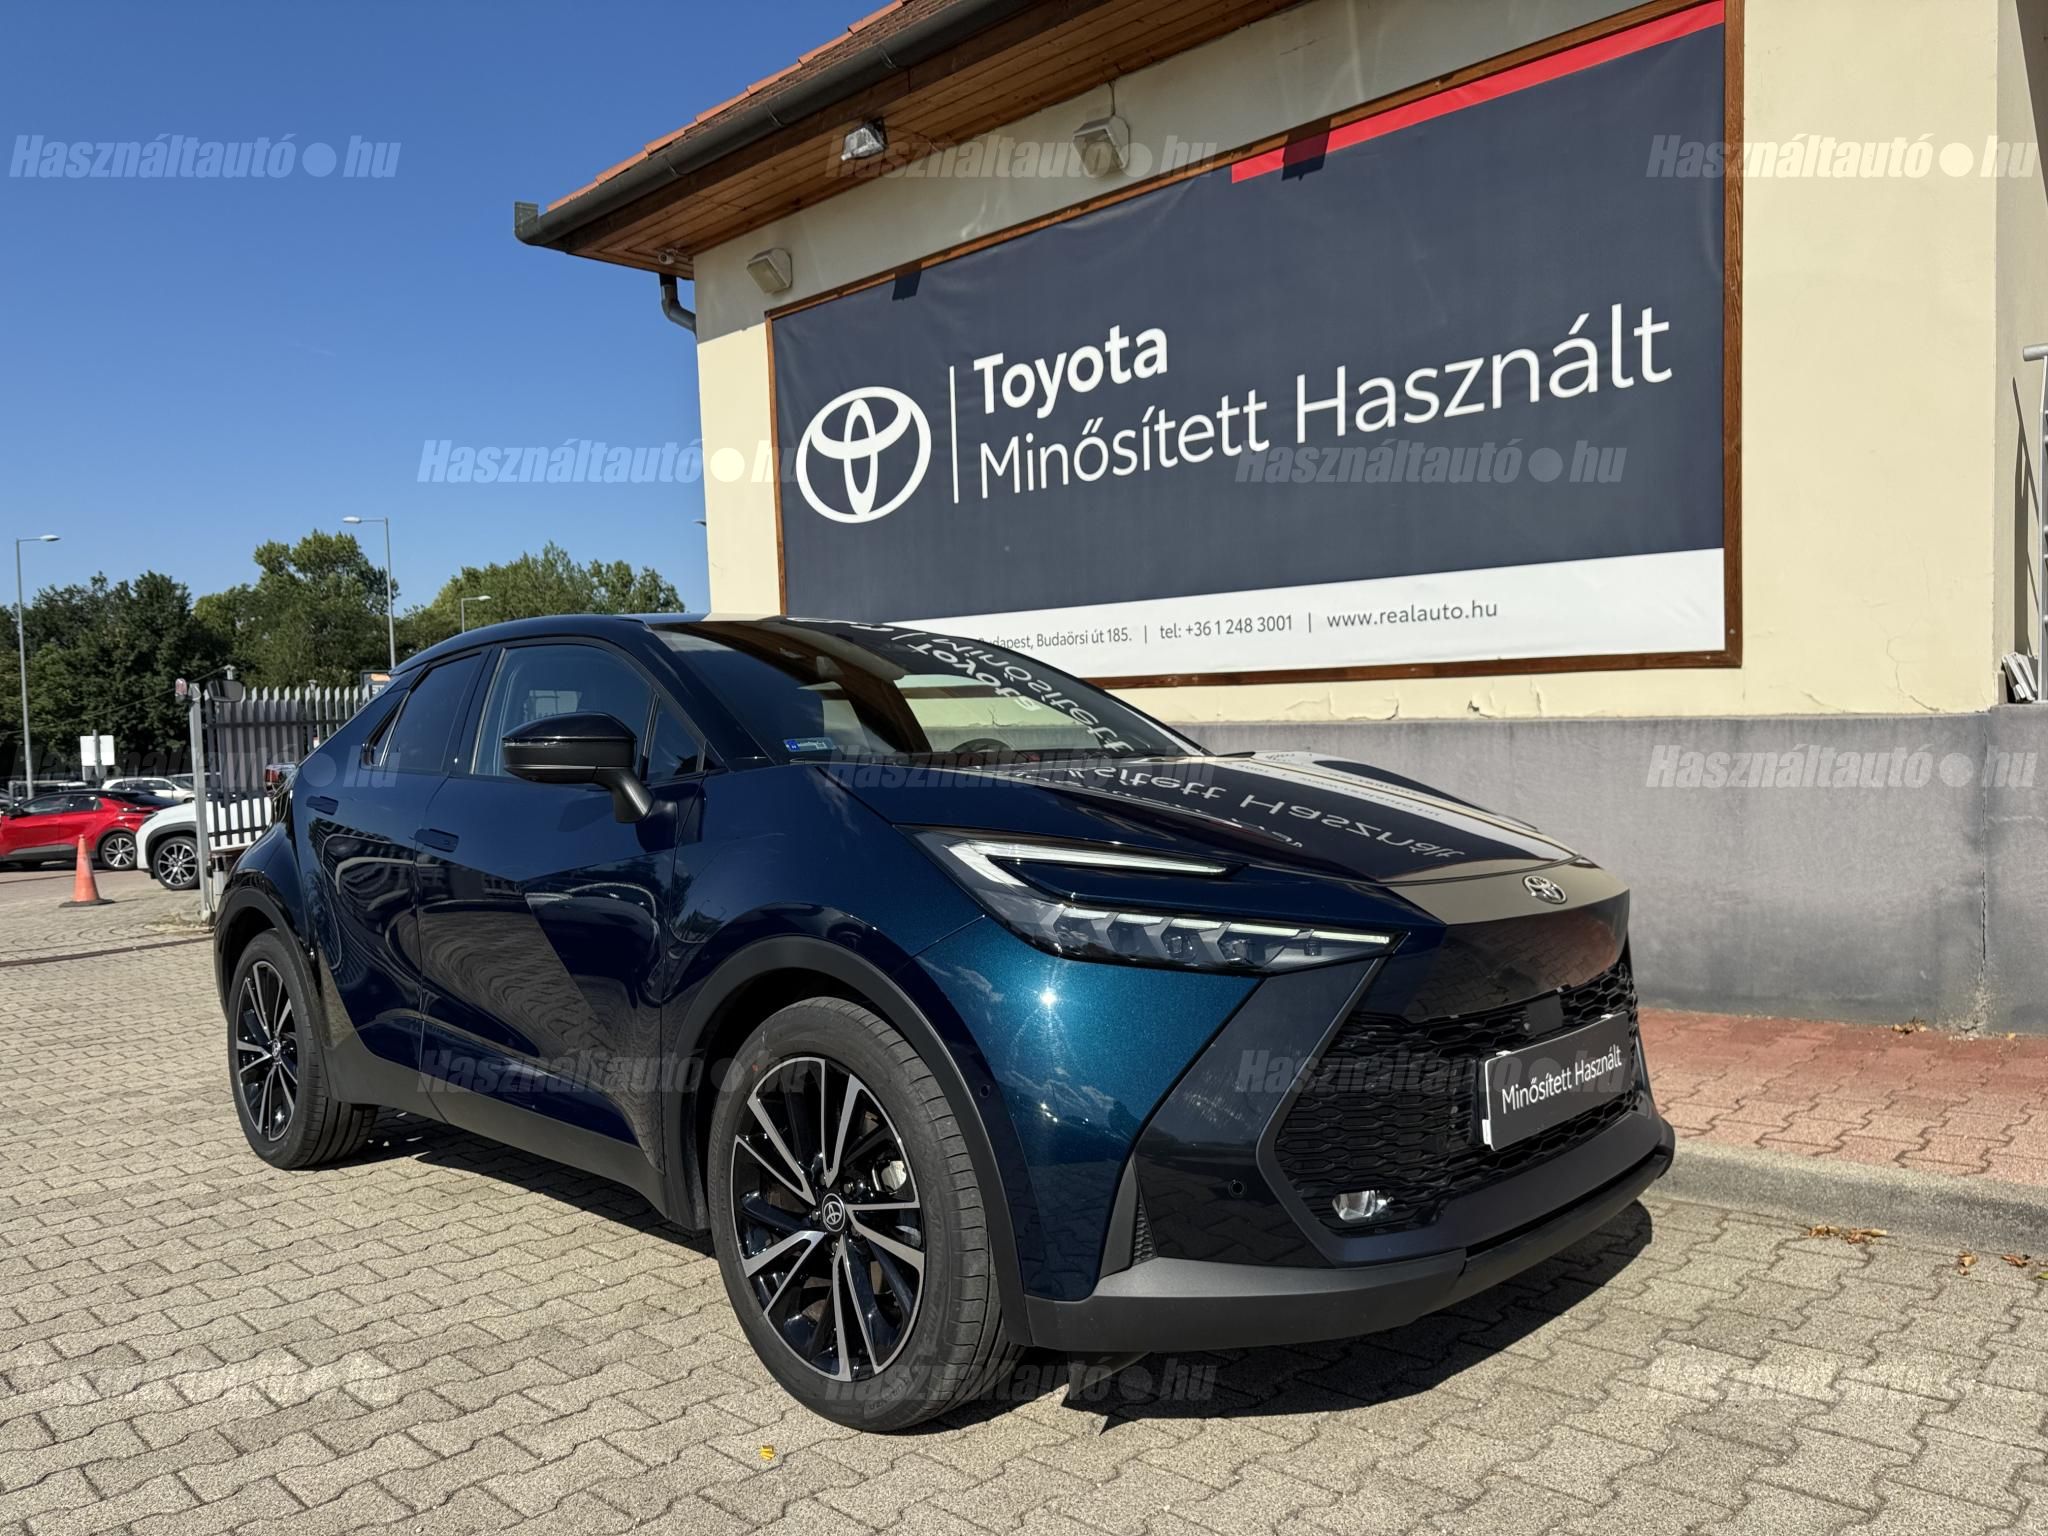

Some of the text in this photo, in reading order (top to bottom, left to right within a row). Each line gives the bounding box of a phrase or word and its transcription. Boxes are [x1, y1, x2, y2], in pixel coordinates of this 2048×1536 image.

[973, 325, 1168, 419] Toyota
[980, 304, 1673, 499] Minősített Használt
[1036, 630, 1088, 647] Budaörsi
[1091, 629, 1105, 644] út
[1107, 627, 1132, 642] 185.
[1160, 623, 1182, 639] tel:
[1225, 617, 1253, 634] 248
[1257, 614, 1292, 632] 3001
[1326, 599, 1498, 628] www.realauto.hu
[1501, 1043, 1623, 1114] Minősített Használt
